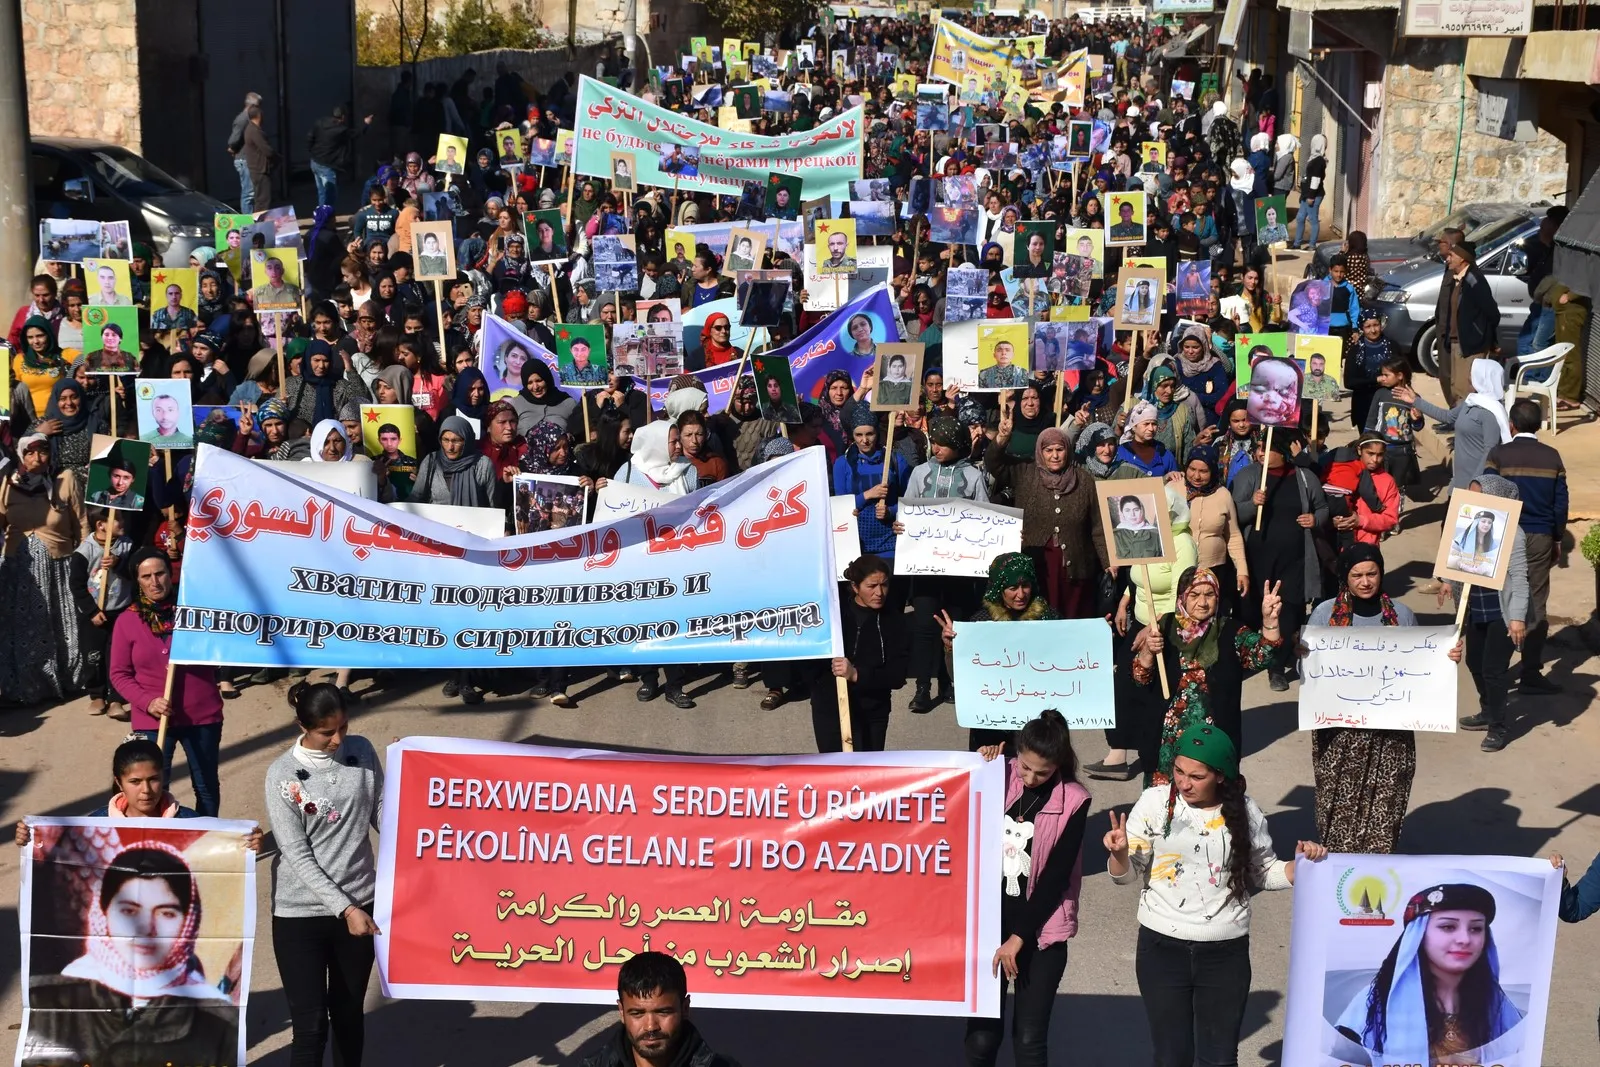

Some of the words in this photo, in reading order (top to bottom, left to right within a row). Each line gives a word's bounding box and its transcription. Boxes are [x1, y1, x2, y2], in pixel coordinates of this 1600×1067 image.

[587, 96, 643, 122] التركي
[582, 127, 601, 141] не
[774, 152, 857, 172] турецкой
[186, 487, 334, 543] السوري
[735, 479, 810, 550] كفى
[903, 503, 956, 517] الاحتلال
[932, 546, 986, 562] السورية
[288, 567, 426, 605] хватит
[431, 577, 678, 612] подавливать
[683, 571, 711, 597] и
[172, 605, 448, 649] игнорировать
[454, 619, 680, 656] сирийского
[685, 602, 825, 644] народа
[971, 647, 1026, 669] الأمة
[1030, 651, 1100, 673] عاشت
[1308, 664, 1375, 679] الاحتلال
[980, 678, 1081, 703] الديمقراطية
[1336, 684, 1411, 706] التركي
[427, 776, 638, 815] BERXWEDANA
[651, 783, 790, 819] SERDEMÊ
[798, 784, 818, 820] Û
[826, 785, 947, 823] RÛMETÊ
[415, 823, 574, 864] PÊKOLÎNA
[581, 833, 715, 868] GELAN.E
[729, 838, 752, 869] JI
[761, 838, 807, 870] BO
[813, 838, 951, 875] AZADIYÊ
[495, 888, 642, 927] والكرامة
[642, 895, 732, 929] العصر
[738, 898, 869, 933] مقاومة
[451, 931, 575, 969] الحرية
[703, 940, 817, 977] الشعوب
[819, 945, 912, 983] إصرار
